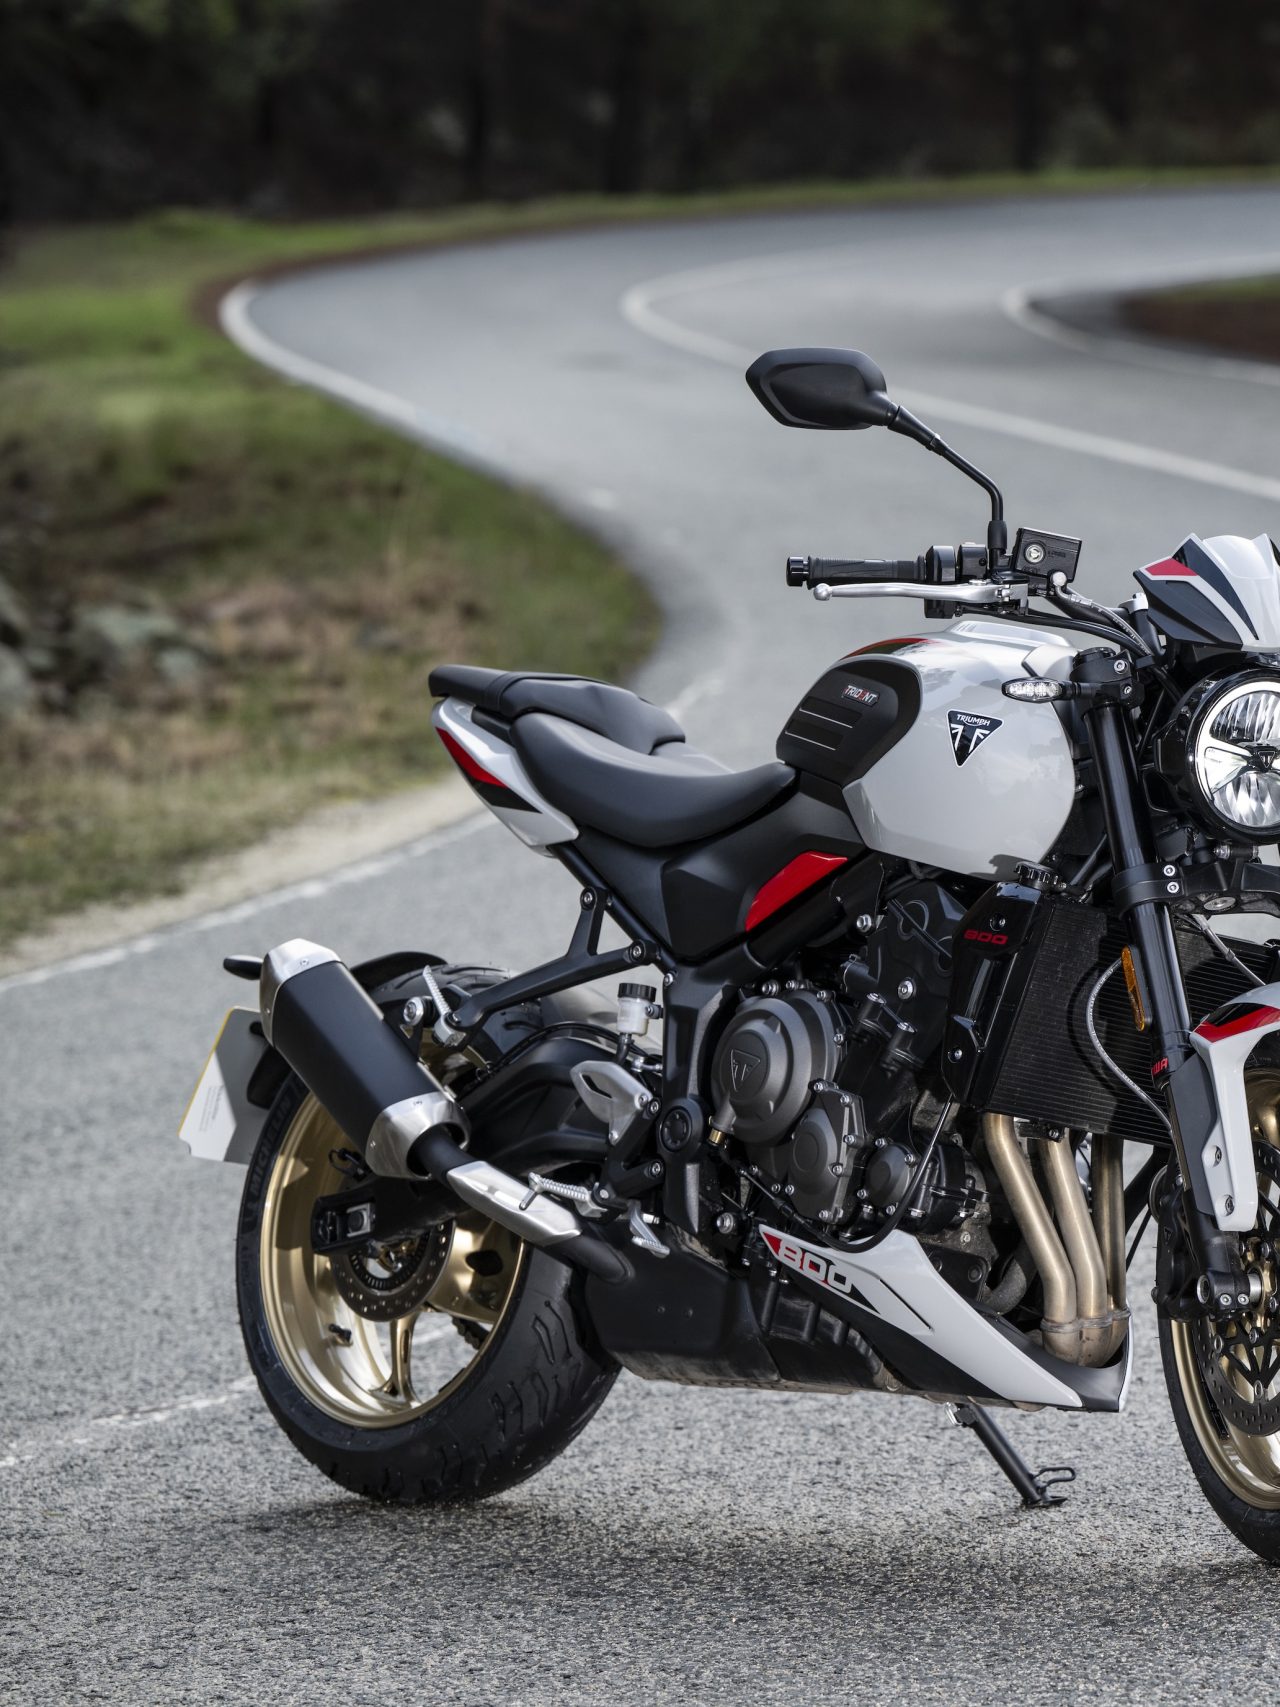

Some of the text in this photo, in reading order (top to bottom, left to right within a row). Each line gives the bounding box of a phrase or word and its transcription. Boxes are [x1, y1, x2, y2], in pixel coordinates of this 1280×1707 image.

[956, 713, 991, 726] TRIUMPH
[964, 929, 1009, 945] 800
[249, 1096, 292, 1195] MICHELIN
[778, 1239, 853, 1295] 800
